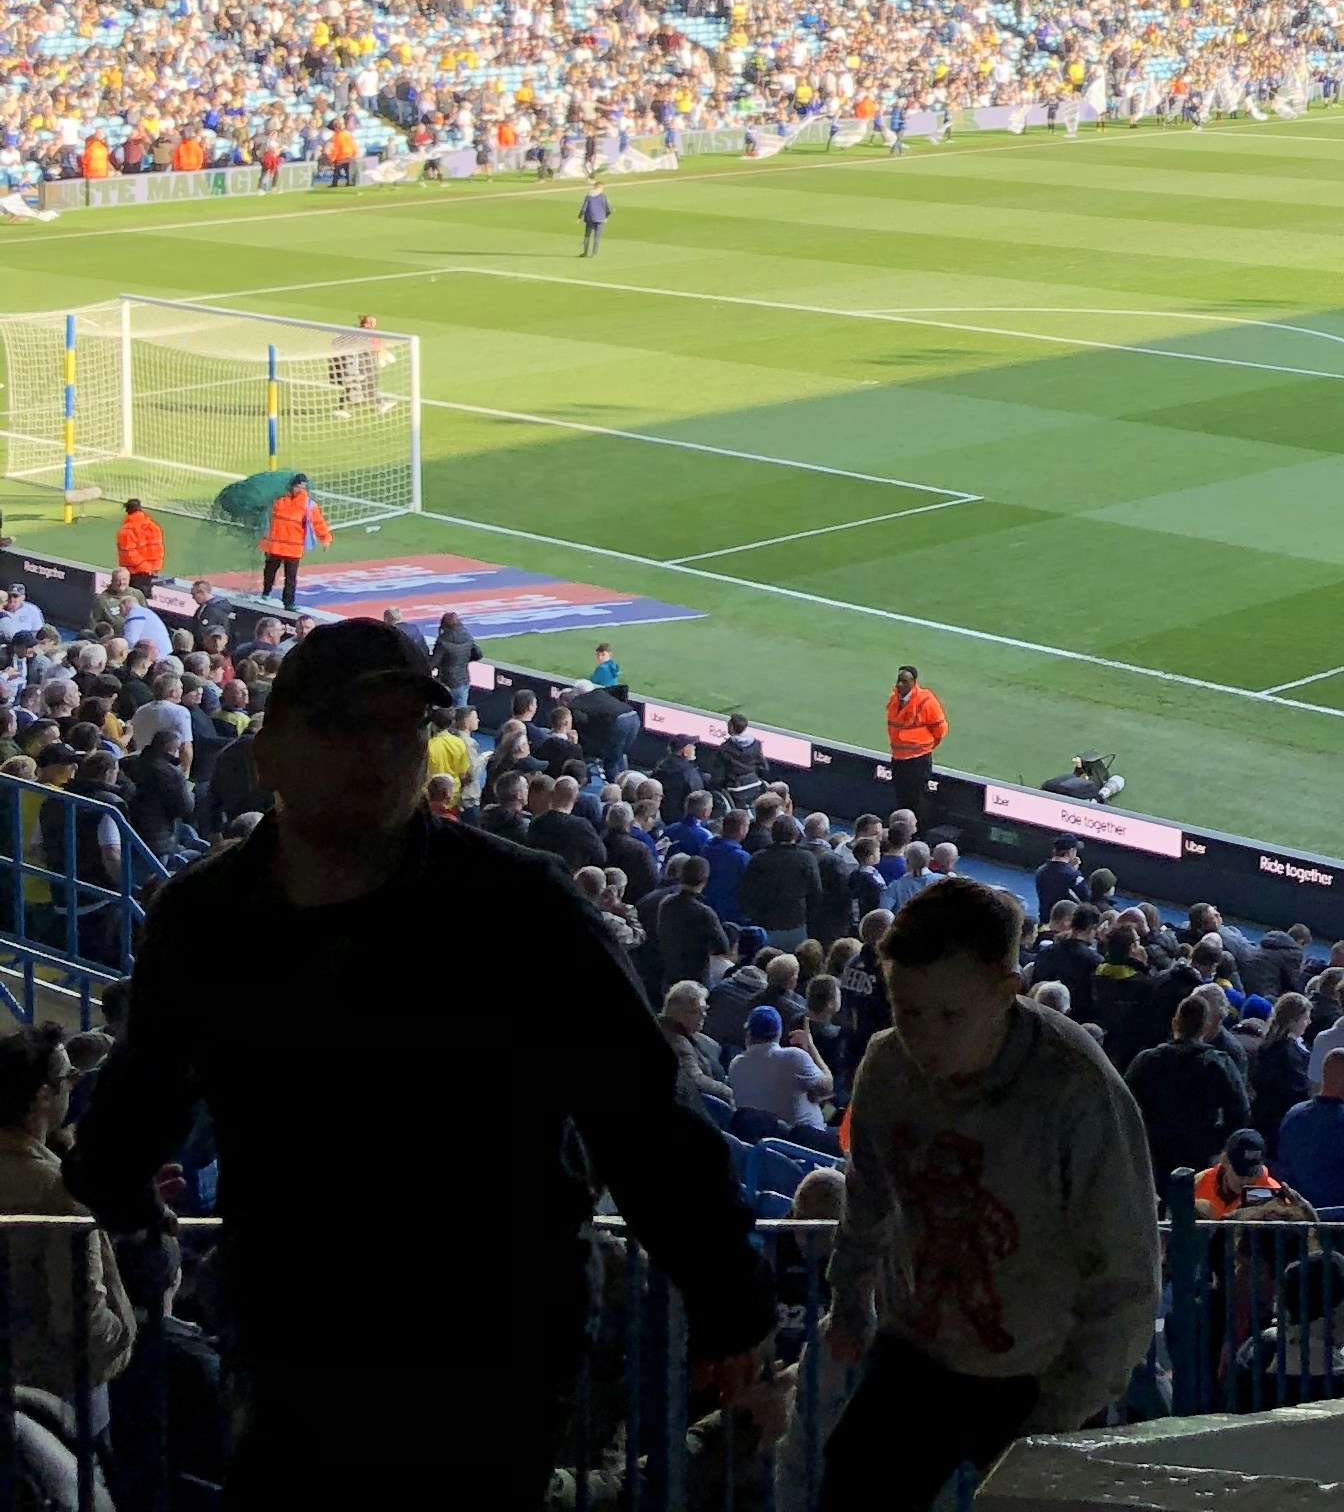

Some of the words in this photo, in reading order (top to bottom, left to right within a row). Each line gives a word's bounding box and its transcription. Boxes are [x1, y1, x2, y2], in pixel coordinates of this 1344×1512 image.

[813, 751, 832, 765] Uber
[991, 794, 1009, 807] Uber
[1061, 808, 1083, 826] Ride
[1084, 813, 1127, 836] together
[1185, 840, 1206, 855] Uber
[1259, 855, 1285, 875] Ride
[1285, 861, 1334, 886] together
